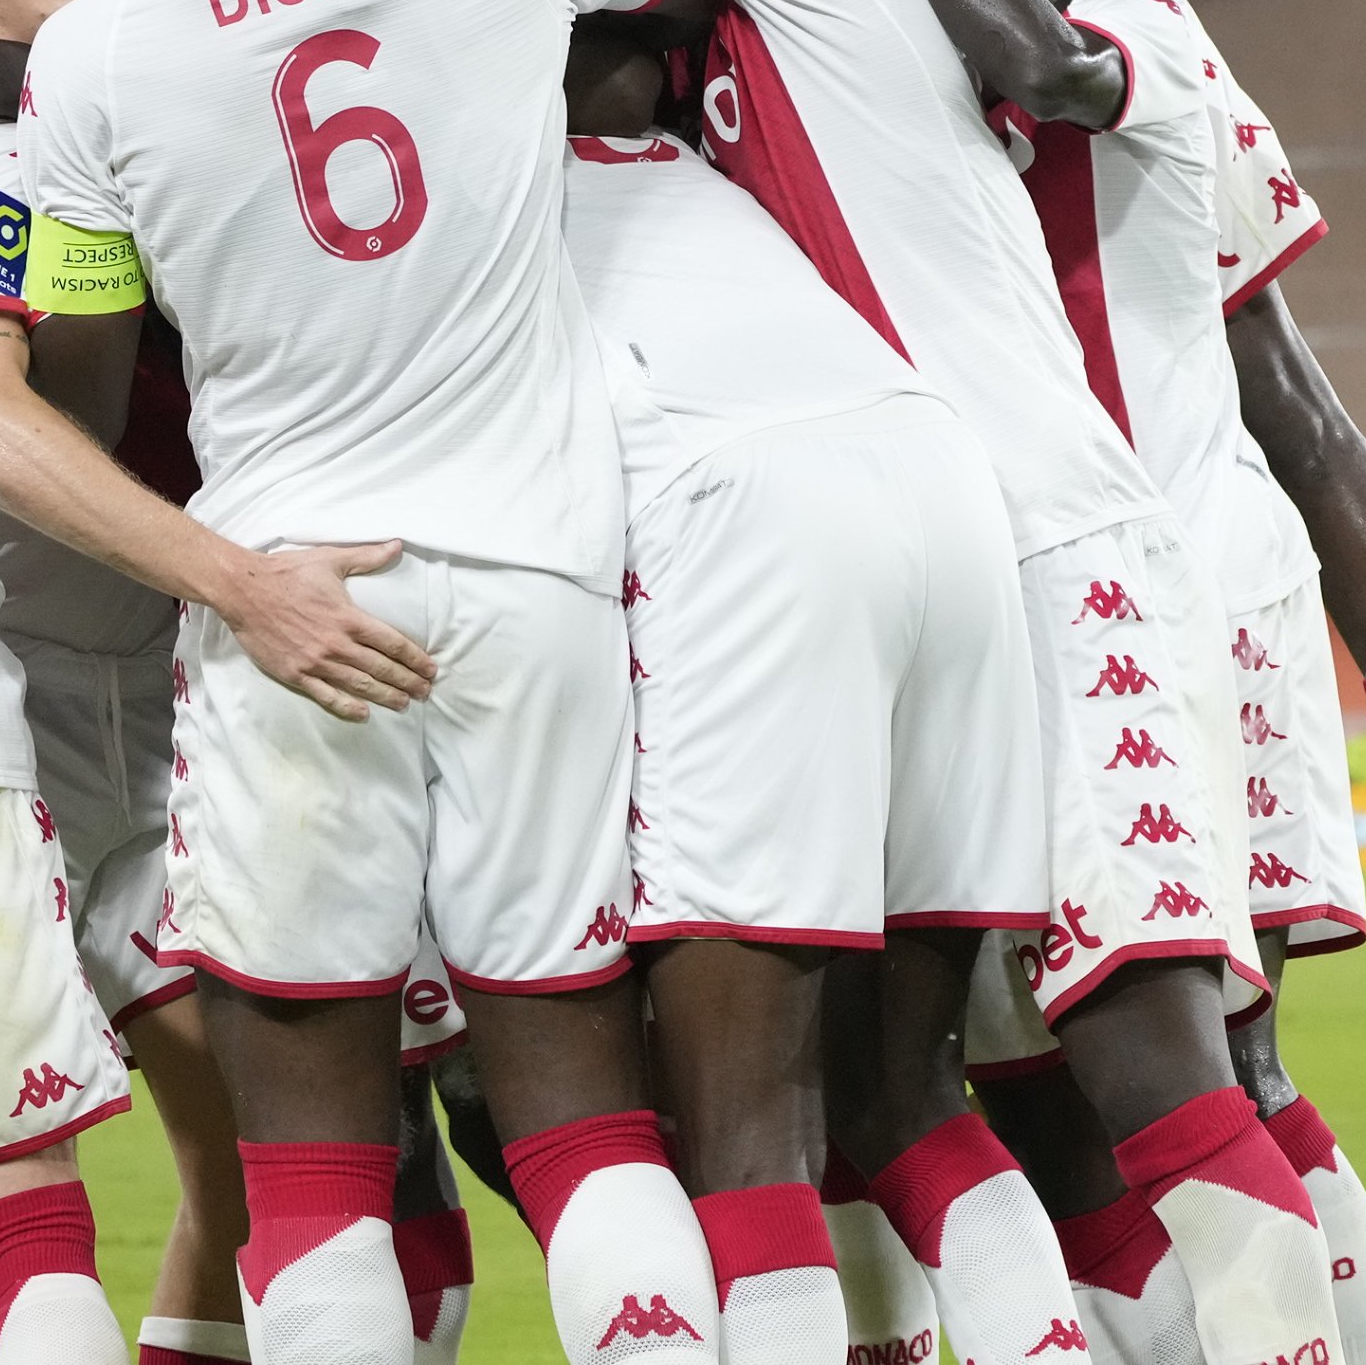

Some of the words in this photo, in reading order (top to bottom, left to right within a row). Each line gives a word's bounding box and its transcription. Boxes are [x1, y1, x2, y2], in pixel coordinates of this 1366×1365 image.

[271, 29, 428, 262] 6
[62, 241, 134, 263] RESPECT
[10, 273, 15, 282] 1
[51, 276, 120, 292] RACISM
[123, 269, 139, 286] TO
